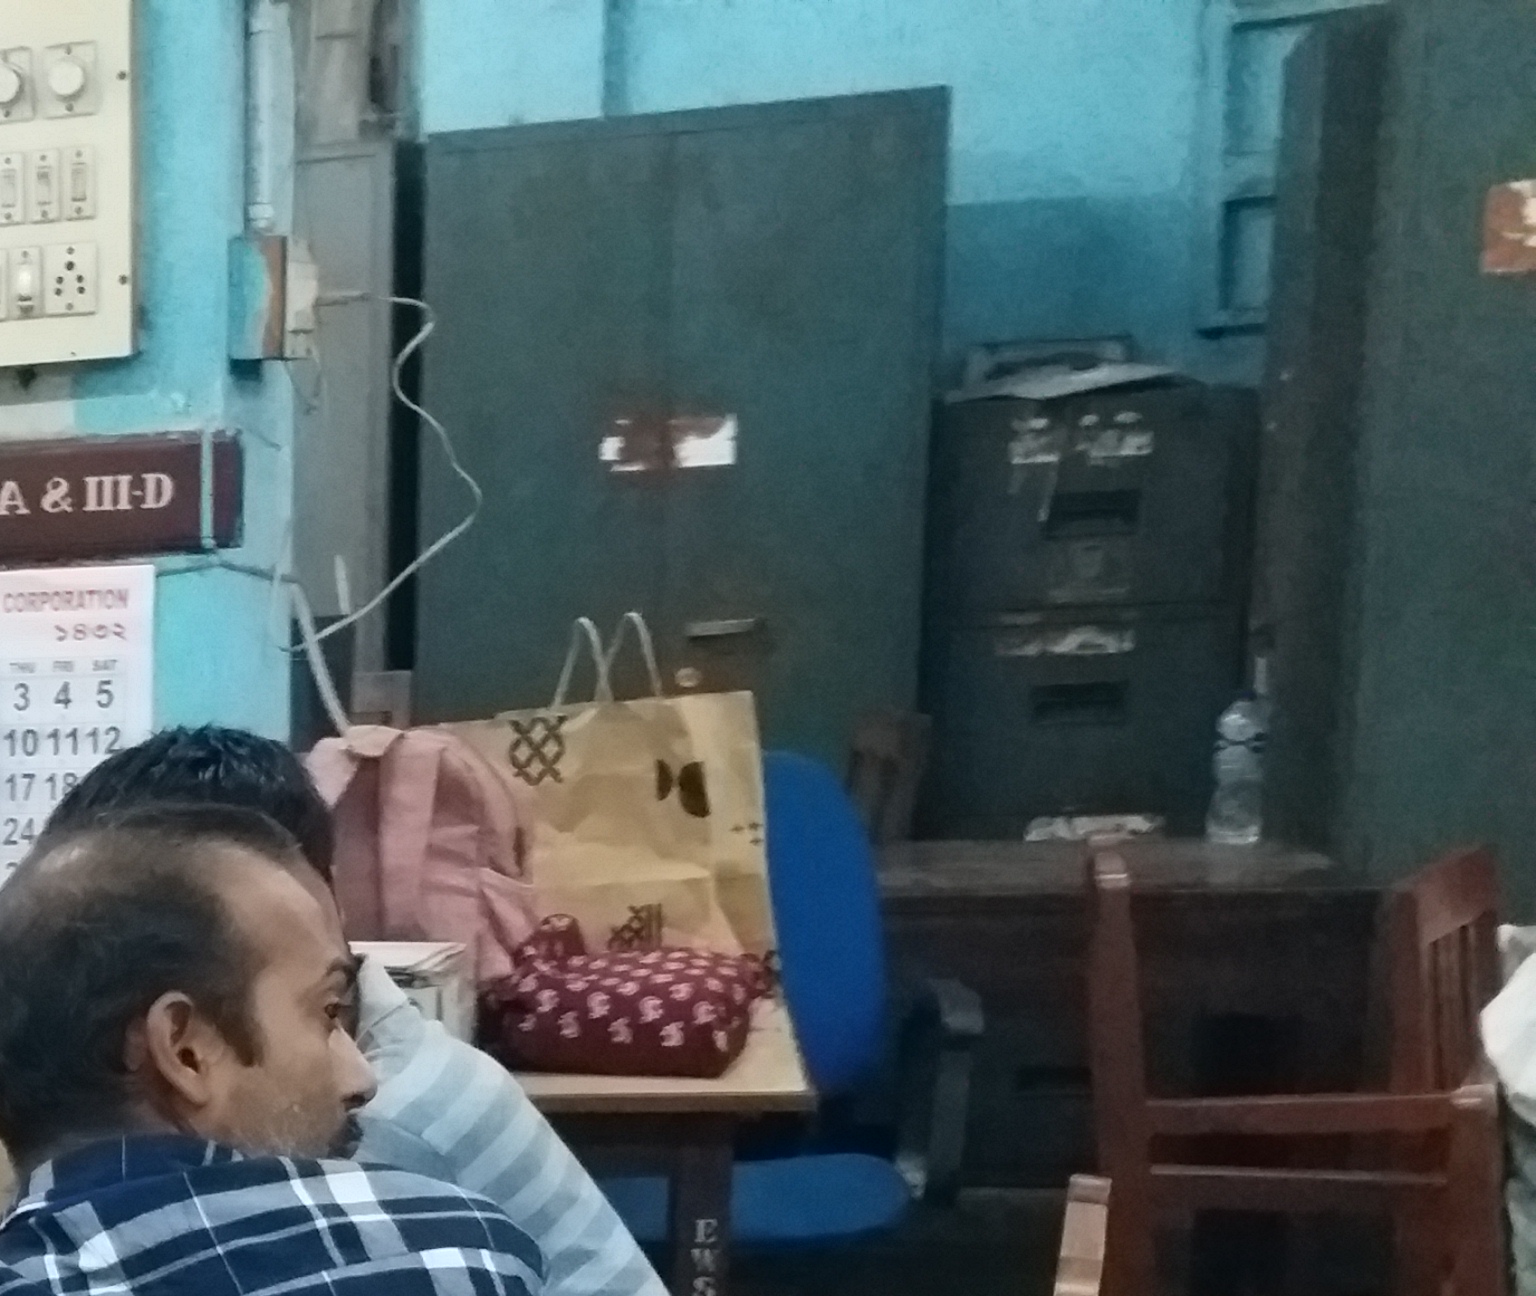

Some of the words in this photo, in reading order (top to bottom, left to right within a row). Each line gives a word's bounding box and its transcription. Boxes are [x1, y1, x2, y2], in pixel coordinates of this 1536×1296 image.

[40, 476, 73, 514] &
[82, 472, 175, 513] III-D
[3, 588, 129, 613] CORPORATION
[13, 682, 30, 712] 3
[54, 681, 72, 709] 4
[97, 679, 115, 708] 5
[4, 728, 39, 757] 10
[46, 727, 80, 757] 11
[86, 725, 123, 755] 12
[5, 772, 35, 802] 17
[3, 816, 35, 846] 24
